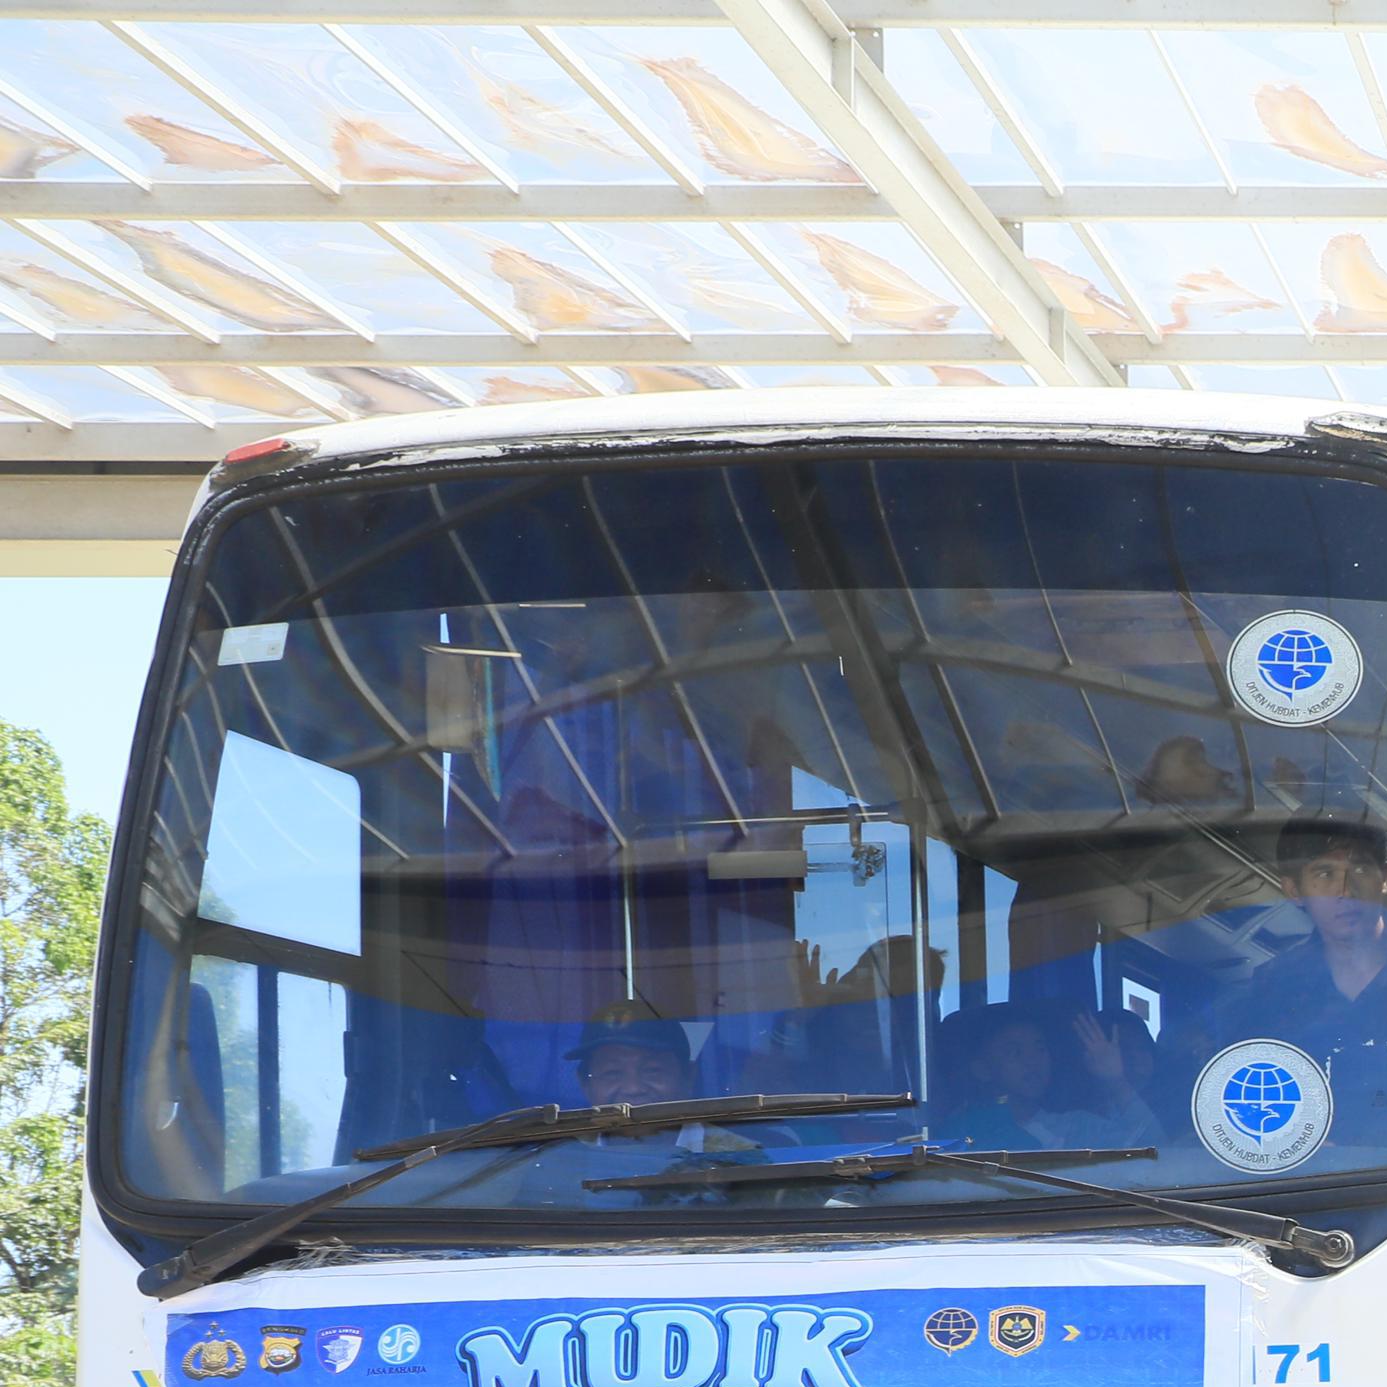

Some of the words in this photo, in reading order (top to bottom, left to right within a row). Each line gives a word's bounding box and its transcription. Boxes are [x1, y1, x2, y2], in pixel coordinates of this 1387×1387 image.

[1266, 699, 1300, 717] HUBDAT
[1308, 682, 1345, 715] KEMENHUB
[1212, 1123, 1235, 1150] DITJEN
[1235, 1147, 1270, 1164] HUBDAT
[1279, 1122, 1315, 1160] KEMENHUB
[1085, 1325, 1170, 1341] DAMRI
[367, 1367, 386, 1376] JASA
[388, 1365, 427, 1375] RAHARJA
